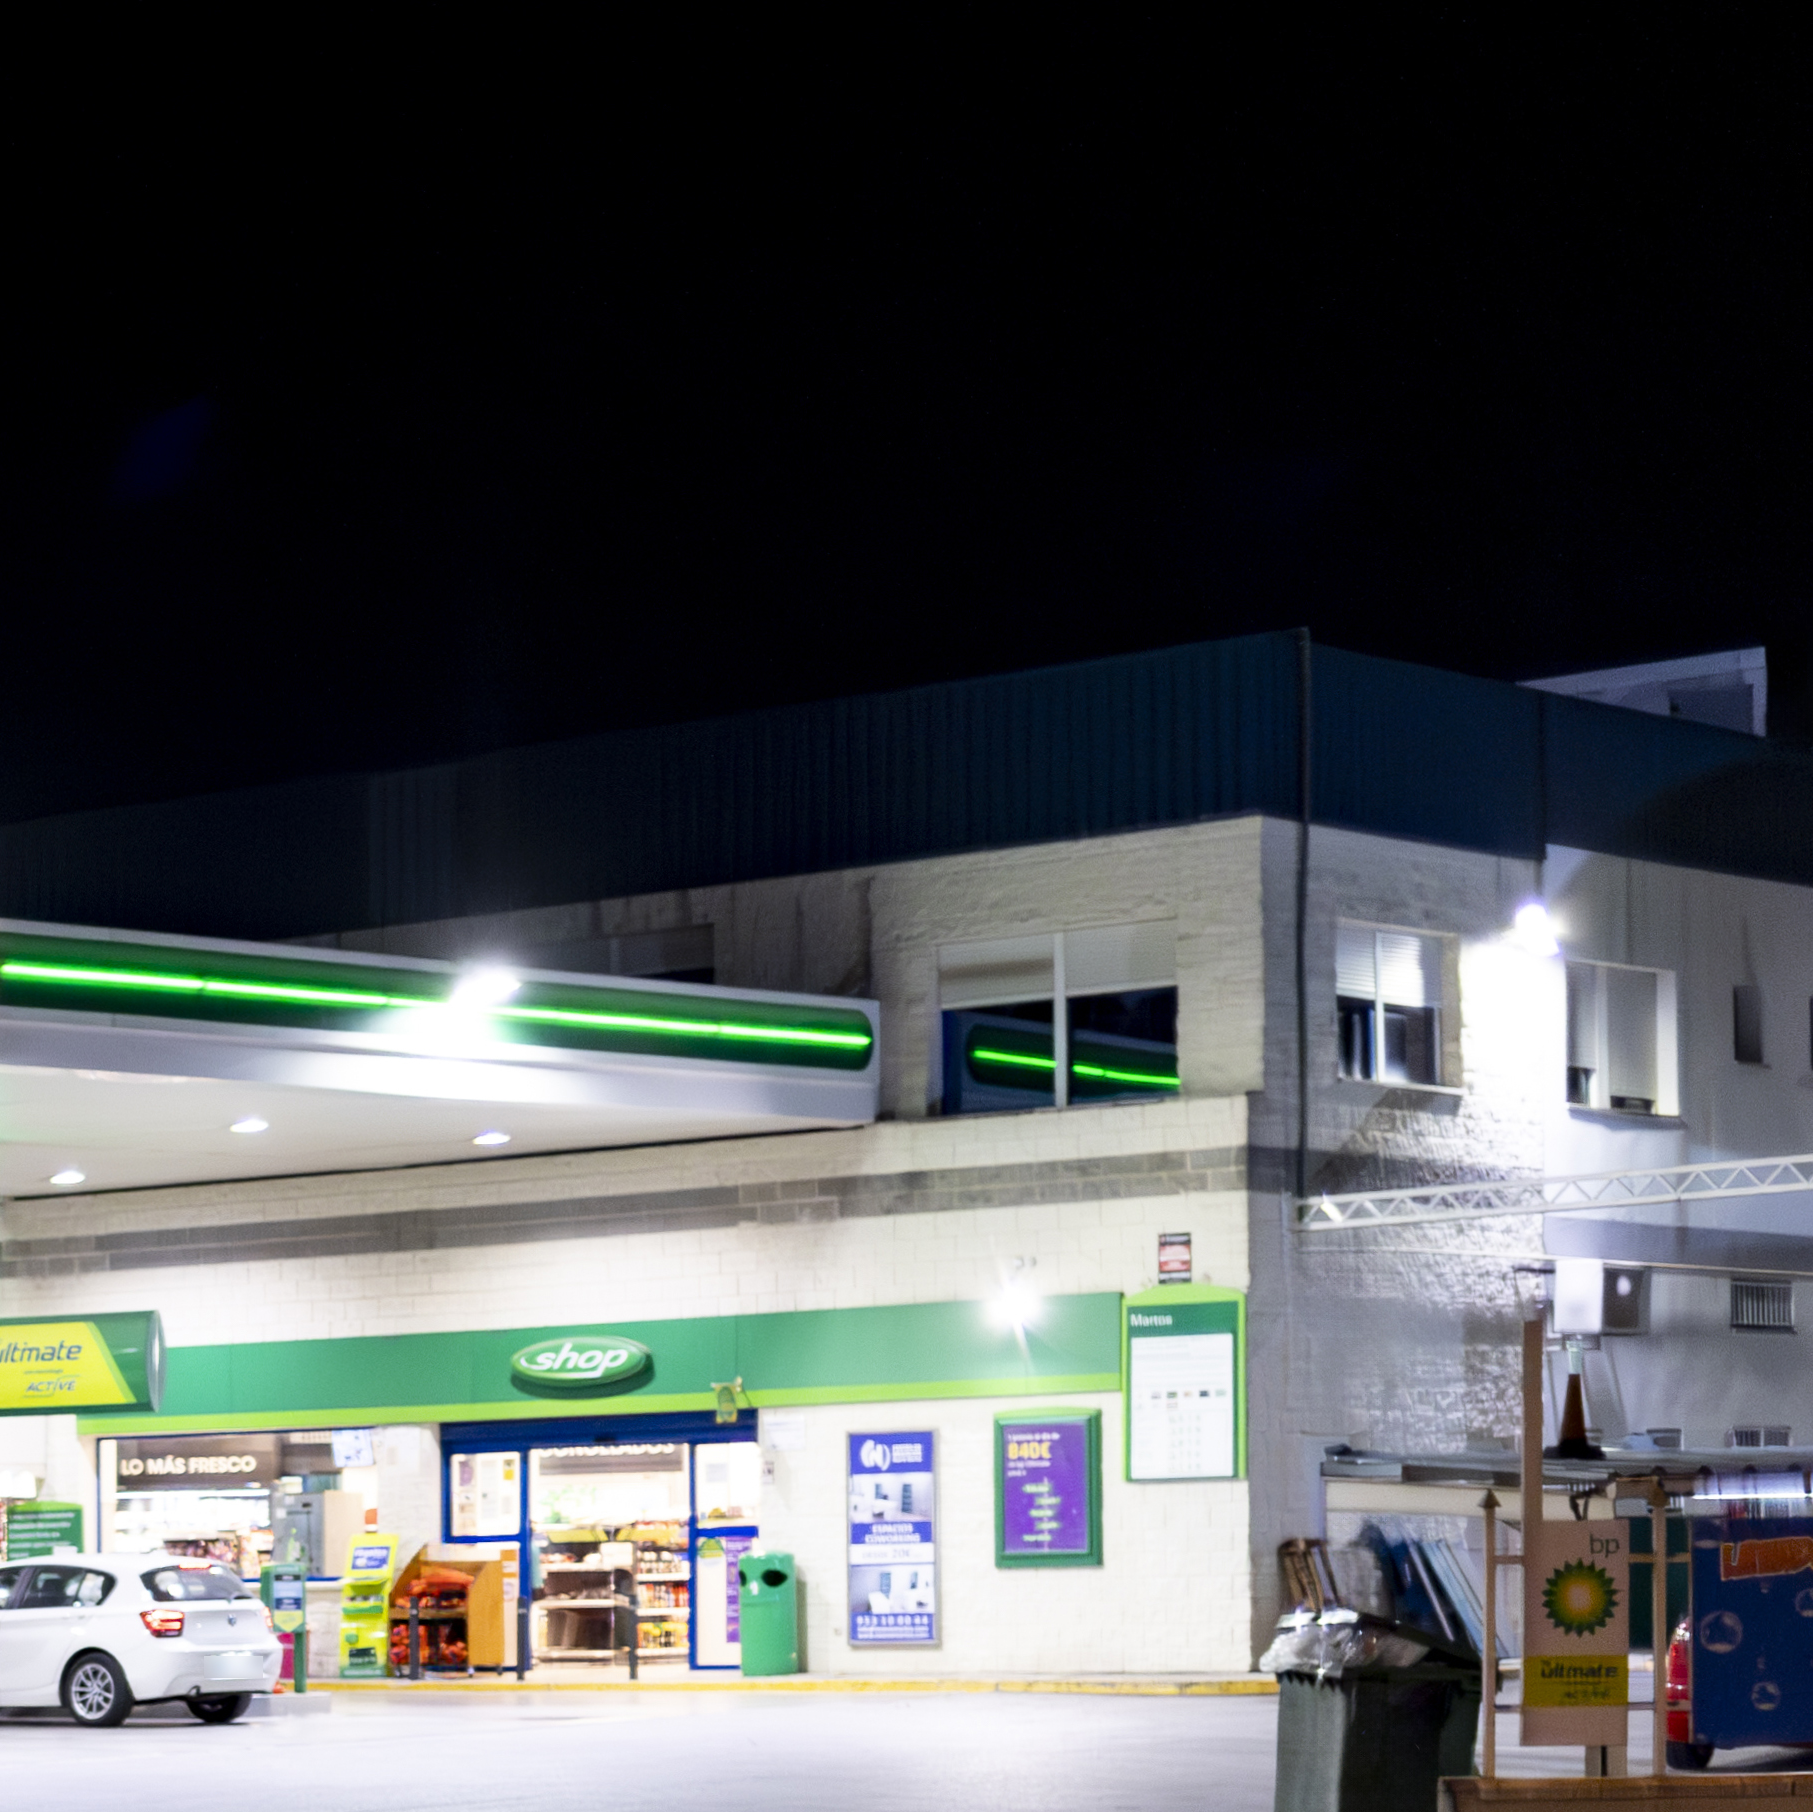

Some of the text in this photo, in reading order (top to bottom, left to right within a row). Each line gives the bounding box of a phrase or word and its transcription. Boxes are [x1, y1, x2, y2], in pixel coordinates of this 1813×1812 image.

[522, 1342, 629, 1378] shop
[25, 1379, 76, 1393] ACTIVE
[119, 1454, 257, 1476] LO MÁS FRESCO
[1589, 1533, 1620, 1558] bp
[1541, 1663, 1618, 1679] ultimate
